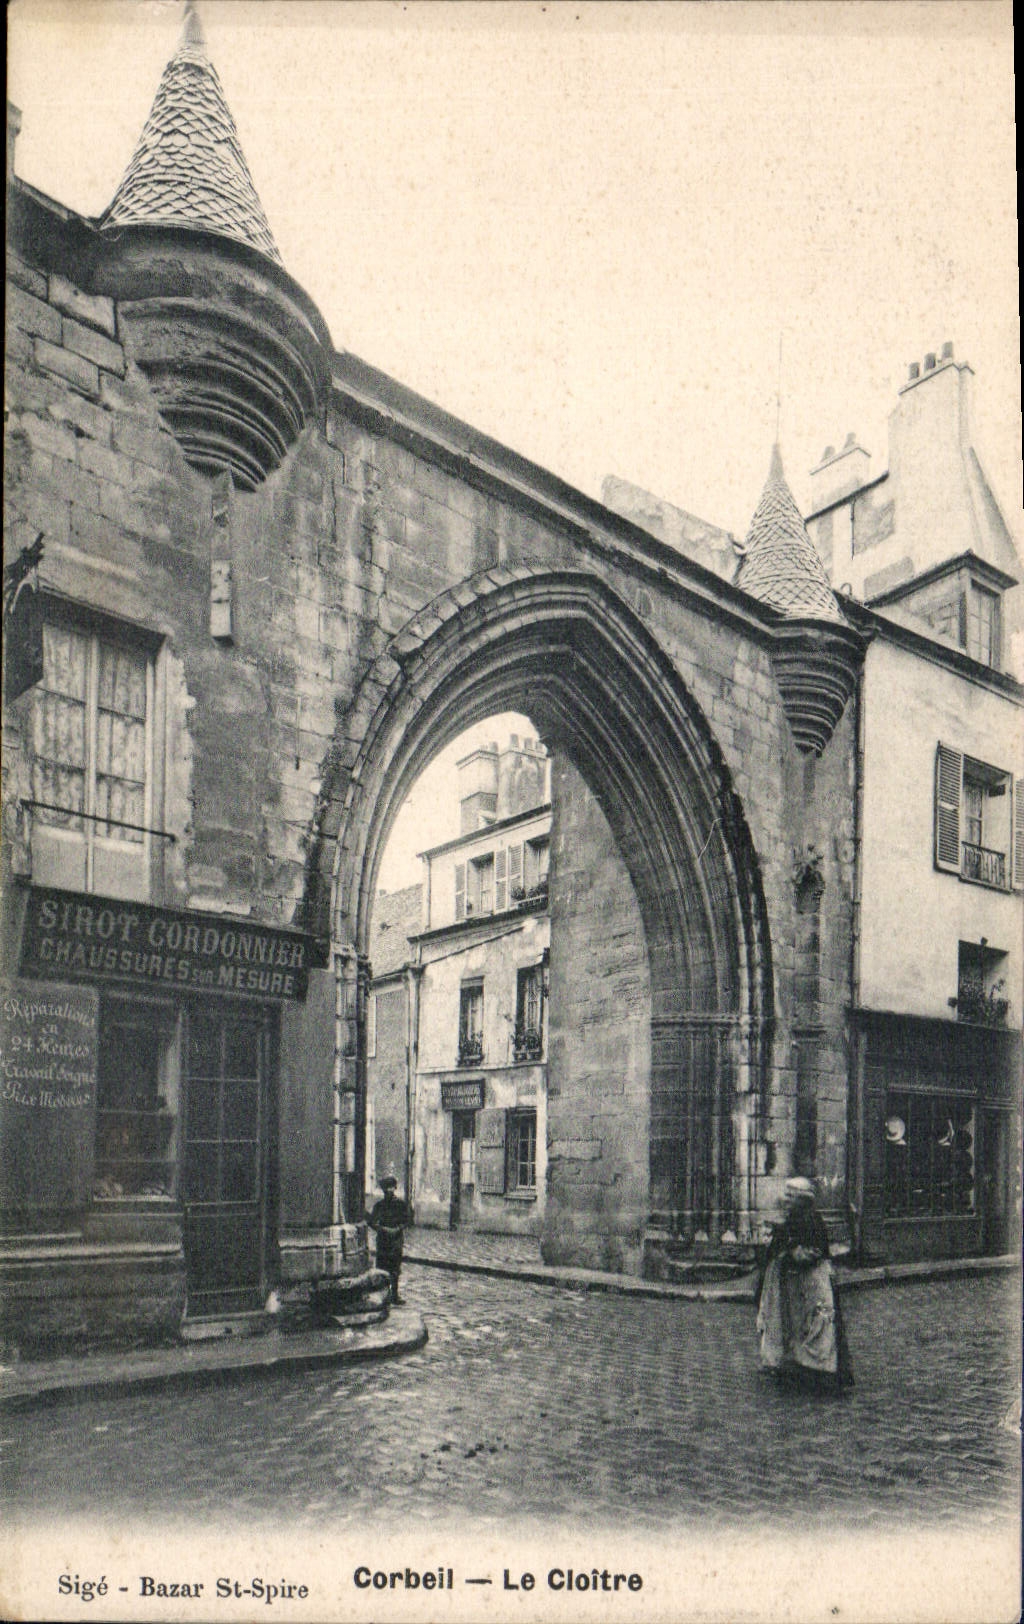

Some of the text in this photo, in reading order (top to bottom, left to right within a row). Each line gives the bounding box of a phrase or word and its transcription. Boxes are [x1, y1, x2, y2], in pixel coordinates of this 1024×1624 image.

[38, 900, 305, 968] SIROT CORDONNIER
[40, 937, 190, 981] CHAUSSURES
[218, 964, 295, 995] MESURE
[11, 1035, 33, 1053] 24
